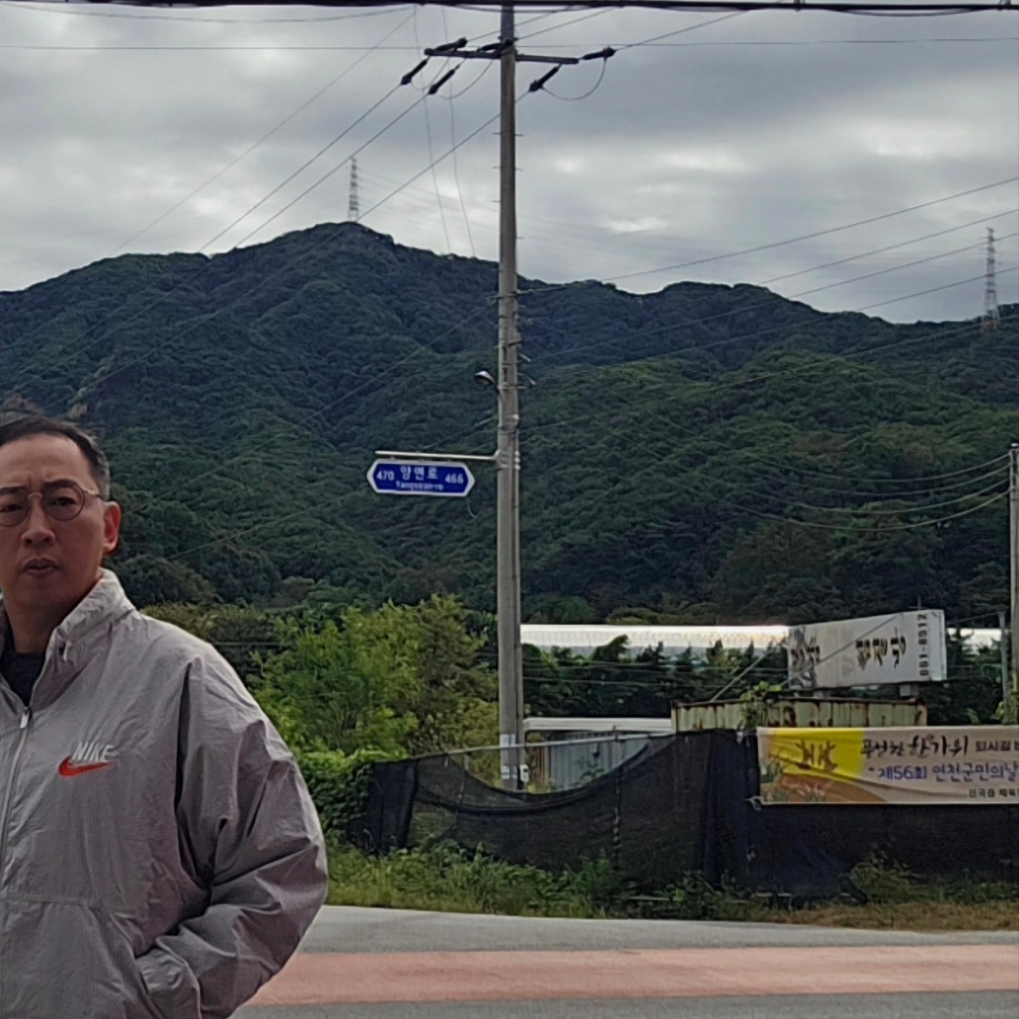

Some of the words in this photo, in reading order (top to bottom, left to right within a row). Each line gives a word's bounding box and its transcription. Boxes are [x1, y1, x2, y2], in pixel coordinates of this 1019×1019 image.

[376, 470, 395, 481] 470
[400, 465, 439, 481] 양연로
[444, 473, 464, 484] 466
[72, 742, 119, 762] NIKE
[907, 734, 969, 759] 한가위
[878, 765, 927, 781] 제56회
